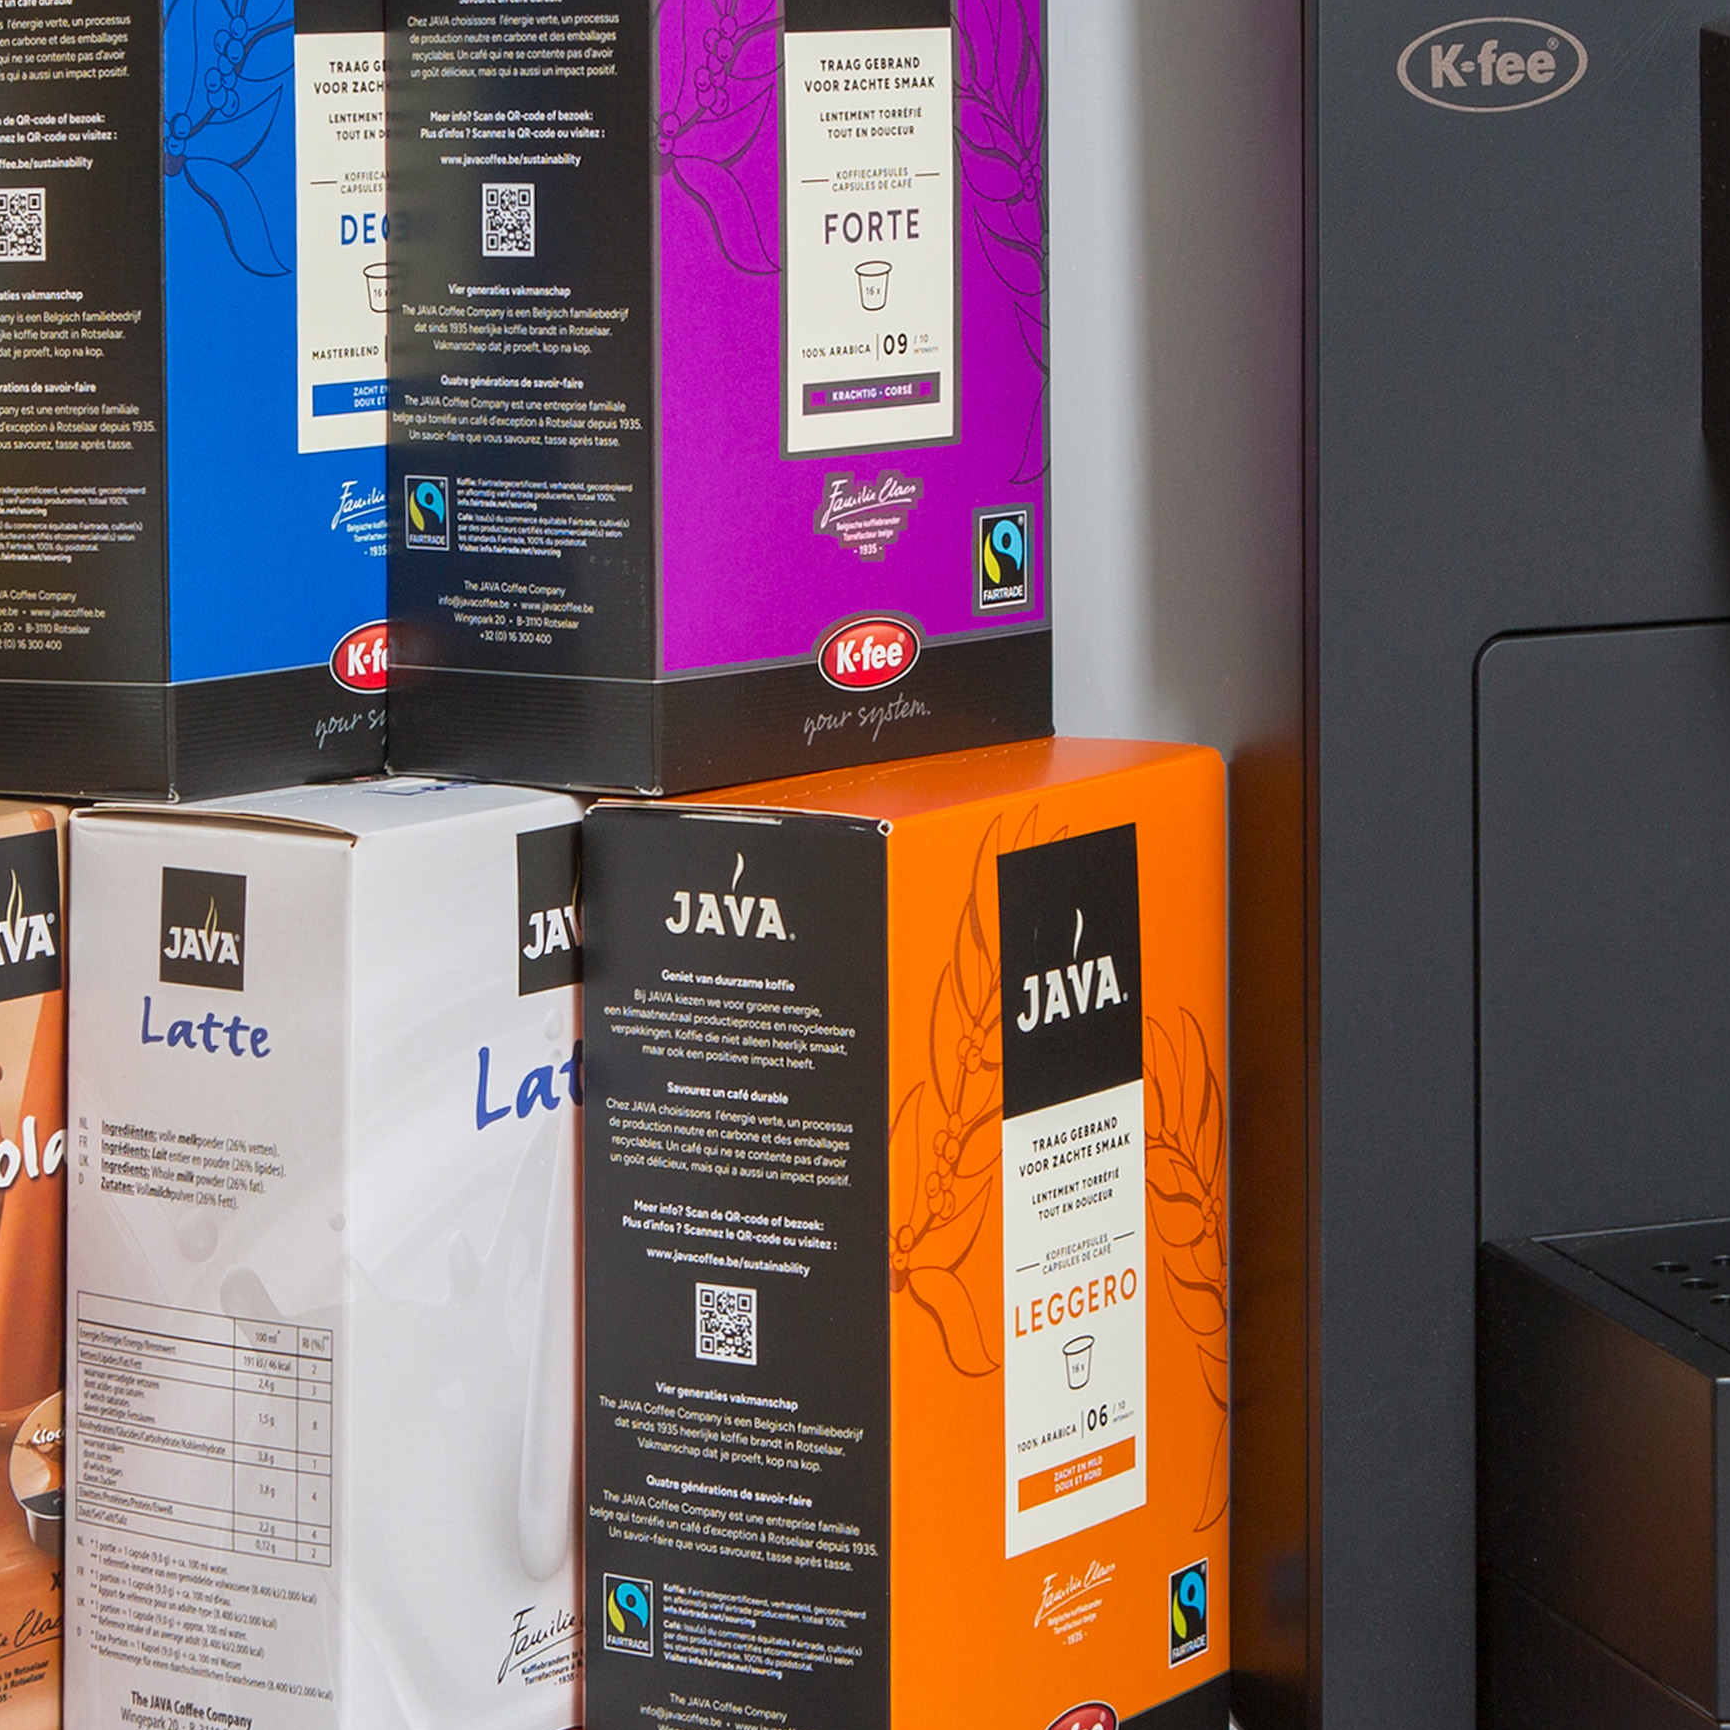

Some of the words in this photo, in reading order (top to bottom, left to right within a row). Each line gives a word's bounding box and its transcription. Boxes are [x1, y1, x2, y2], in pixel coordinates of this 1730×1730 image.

[820, 59, 861, 71] TRAAG
[865, 57, 920, 70] GEBRAND
[805, 80, 839, 92] VOOR
[844, 78, 890, 91] ZACHTE
[895, 77, 934, 89] SMAAK
[825, 209, 919, 244] FORTE
[312, 346, 379, 360] MASTERBLEND
[802, 348, 826, 358] 100%
[830, 344, 870, 355] ARABICA
[884, 333, 907, 355] 09
[833, 388, 877, 401] KRACHTIG
[983, 585, 1023, 601] FAIRTRADE
[804, 711, 852, 746] your
[665, 891, 787, 941] JAVA
[163, 926, 240, 966] JAVA
[695, 975, 713, 984] van
[765, 979, 795, 991] koffie
[1017, 956, 1122, 1032] JAVA
[142, 996, 270, 1058] Latte
[1016, 1268, 1137, 1337] LEGGERO
[1018, 1438, 1038, 1453] 100%
[1041, 1425, 1076, 1444] ARABICA
[1087, 1405, 1108, 1431] 06
[1172, 1635, 1206, 1659] FAIRTRADE
[131, 1691, 148, 1707] The
[150, 1695, 170, 1714] JAVA
[174, 1700, 204, 1719] Coffee
